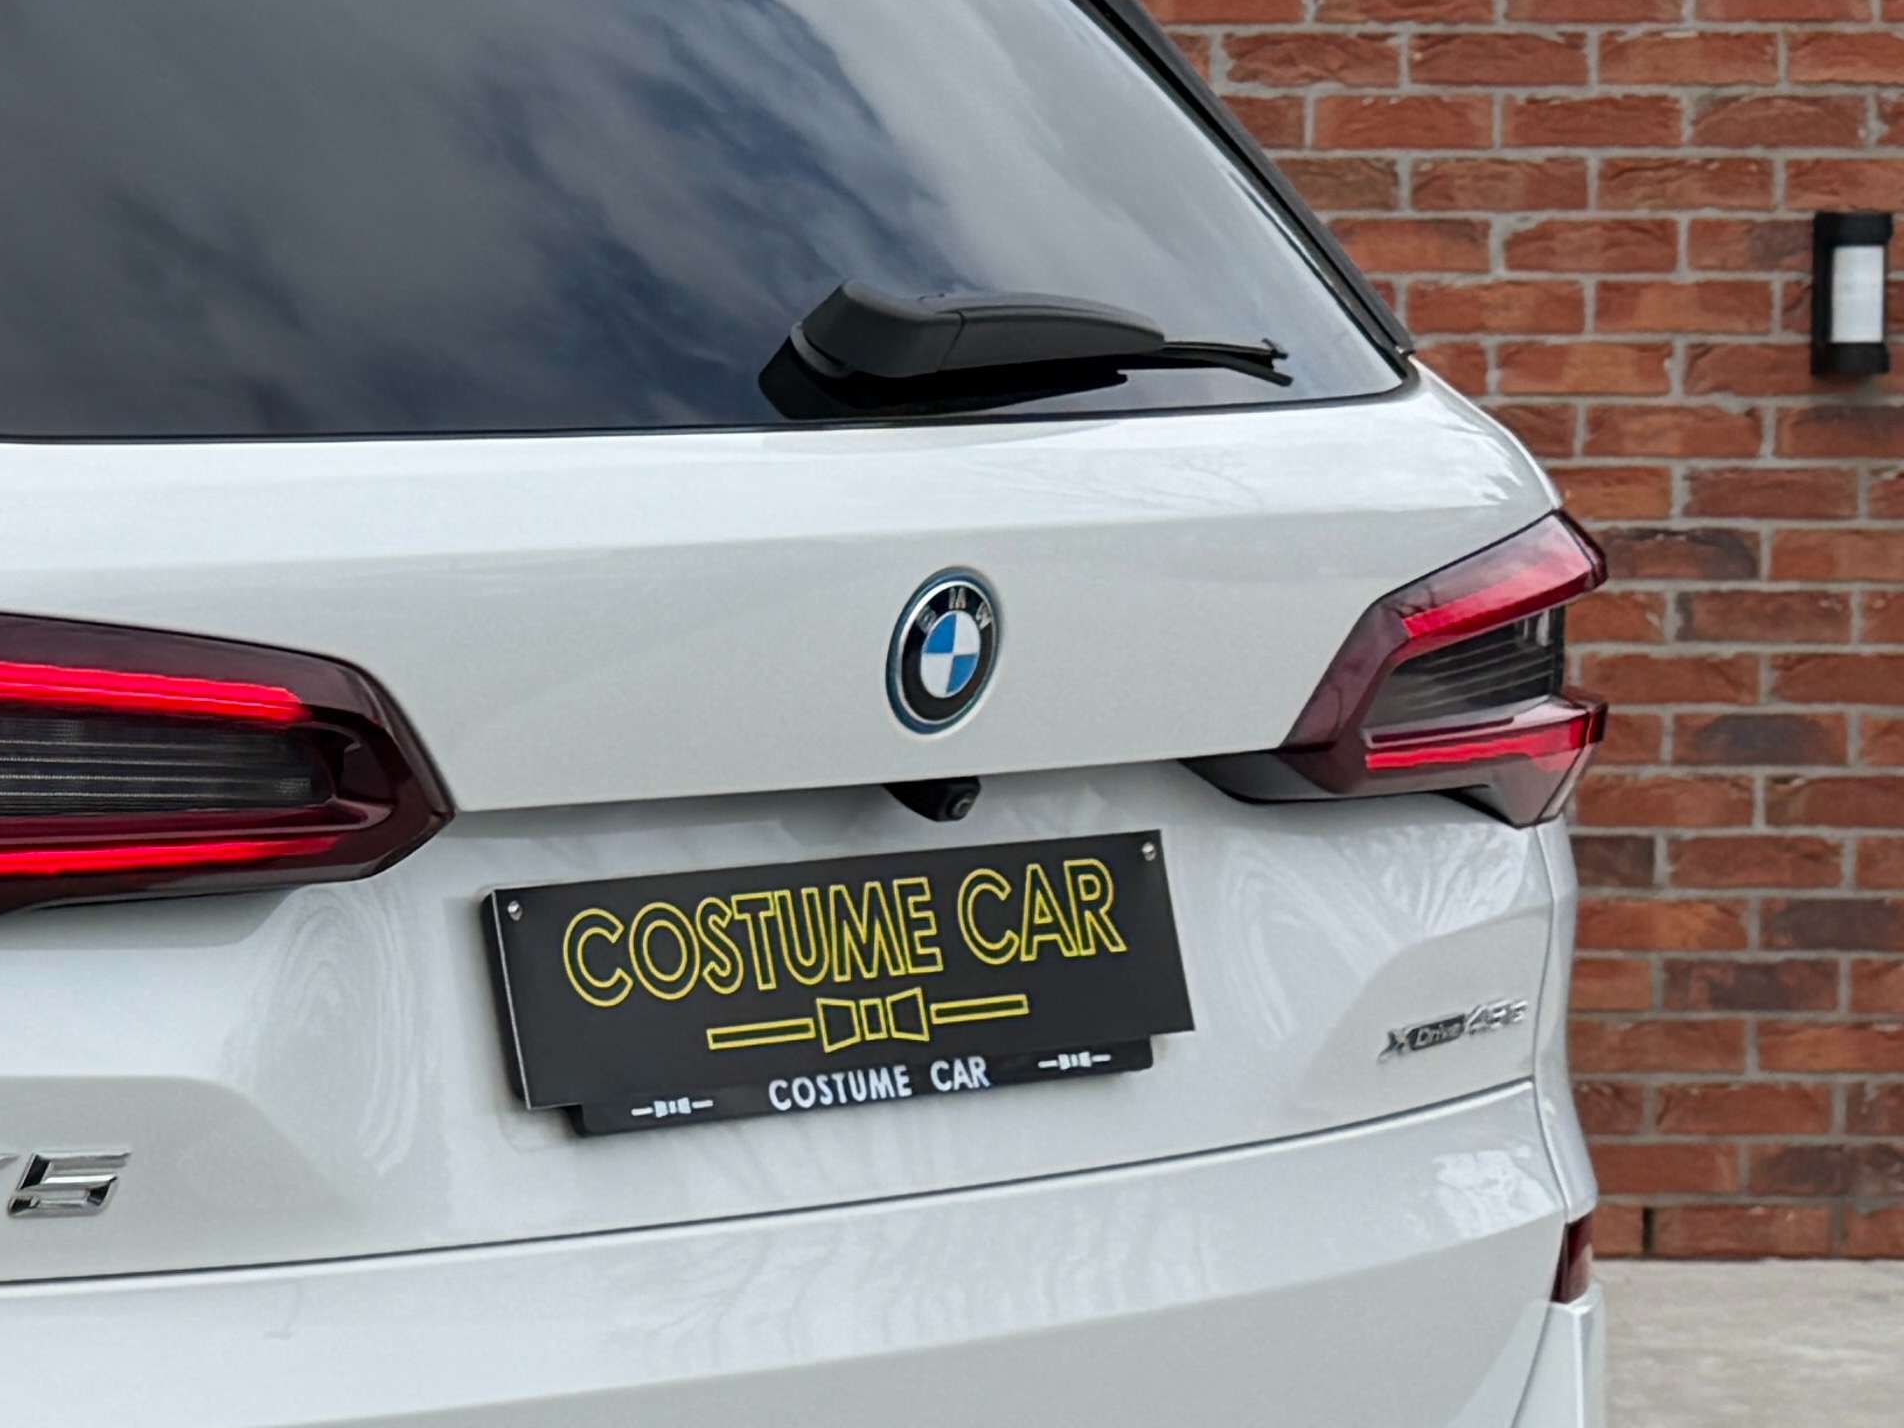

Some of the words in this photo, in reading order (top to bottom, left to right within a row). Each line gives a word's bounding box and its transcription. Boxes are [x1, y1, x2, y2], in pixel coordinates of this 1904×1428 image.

[563, 877, 944, 1006] COSTUME
[958, 859, 1126, 965] CAR
[768, 1064, 913, 1112] COSTUME
[930, 1057, 991, 1093] CAR
